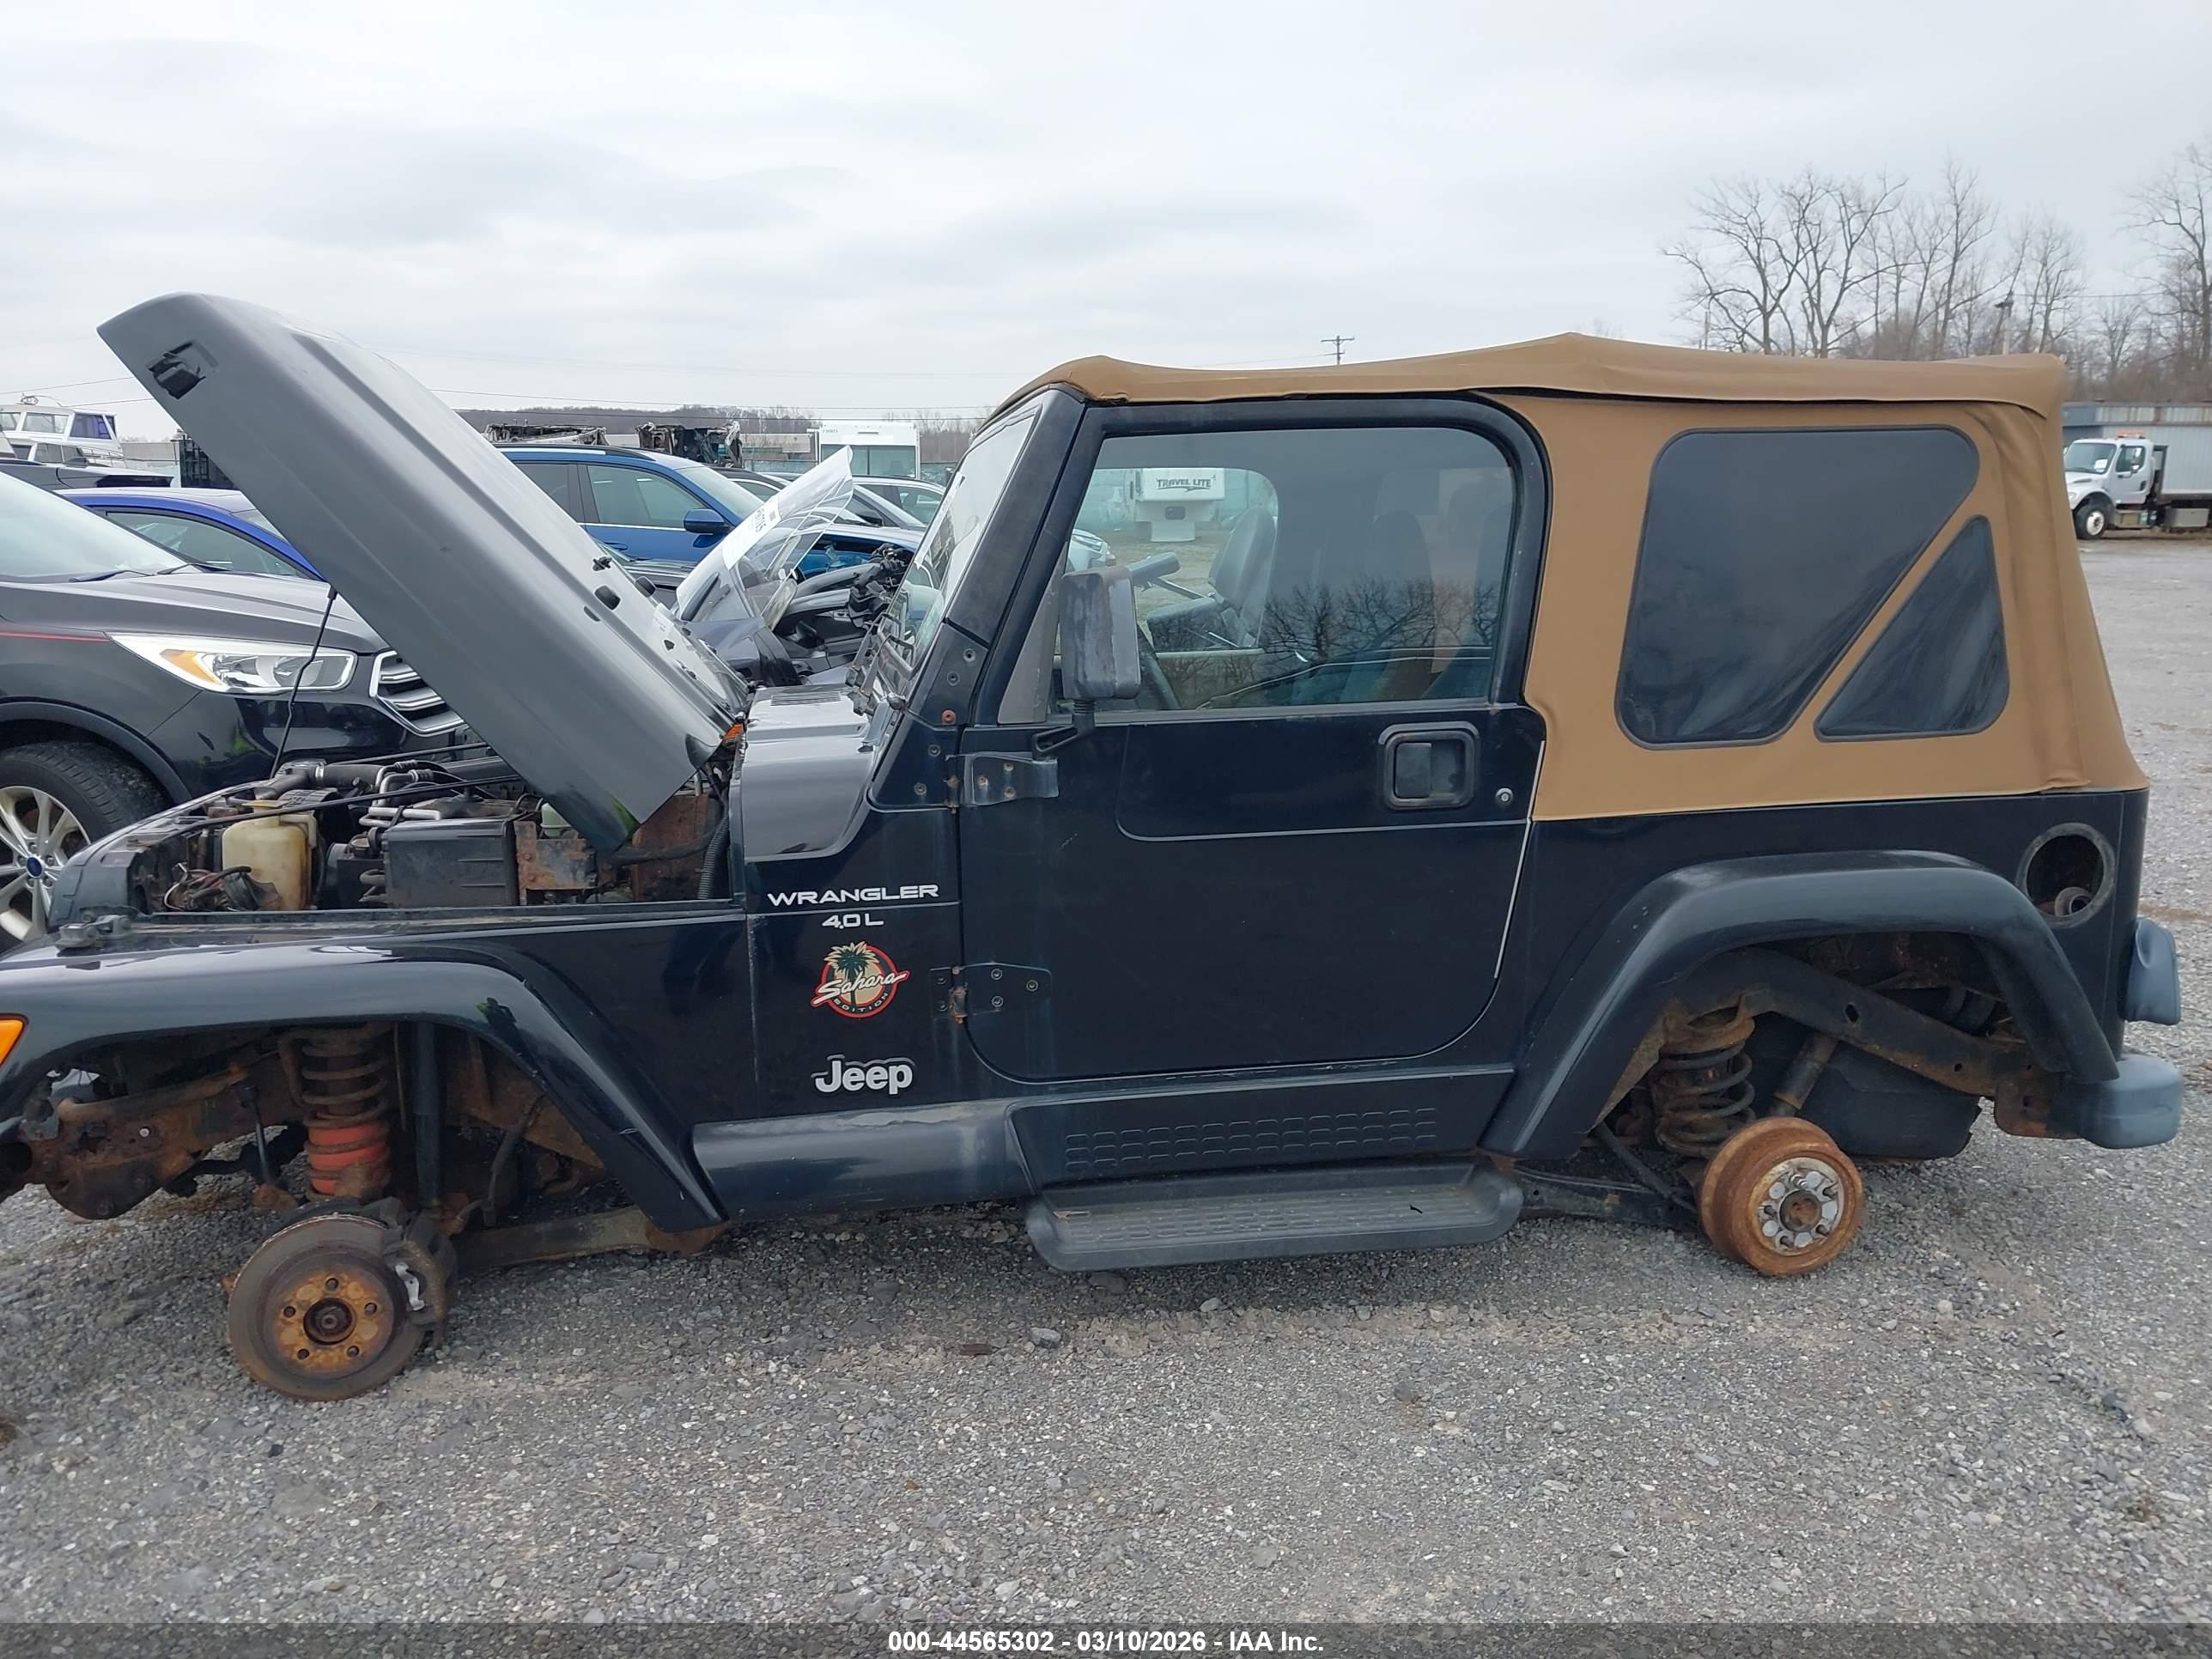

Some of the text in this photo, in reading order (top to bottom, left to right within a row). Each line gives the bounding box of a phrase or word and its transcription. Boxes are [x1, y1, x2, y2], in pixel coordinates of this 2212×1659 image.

[1156, 478, 1211, 488] TRAVEL LITE
[767, 884, 940, 907] WRANGLER
[812, 971, 908, 1005] Sahara
[833, 993, 889, 1012] EDITION
[814, 1059, 913, 1095] Jeep
